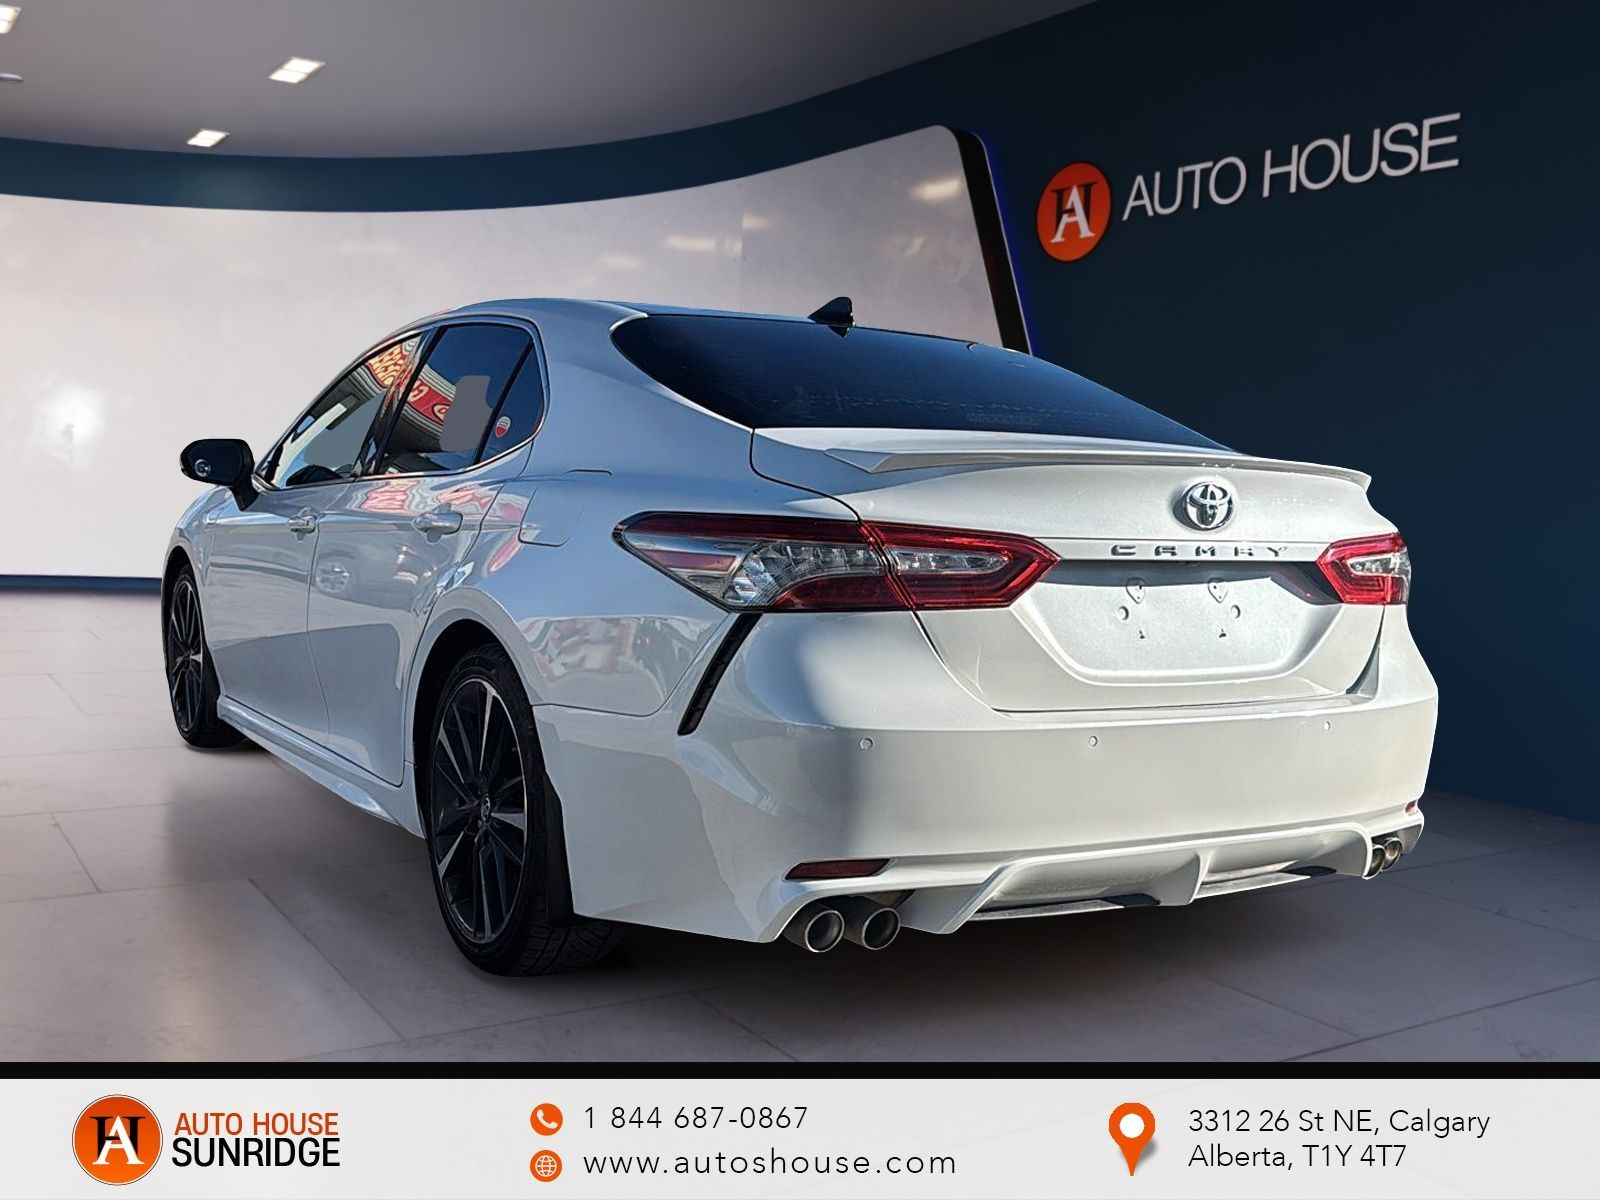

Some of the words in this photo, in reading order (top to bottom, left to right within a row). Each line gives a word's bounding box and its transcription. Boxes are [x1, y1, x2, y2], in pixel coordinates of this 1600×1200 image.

[1122, 156, 1247, 221] AUTO
[1262, 112, 1461, 198] HOUSE
[1110, 544, 1288, 558] CAMRY
